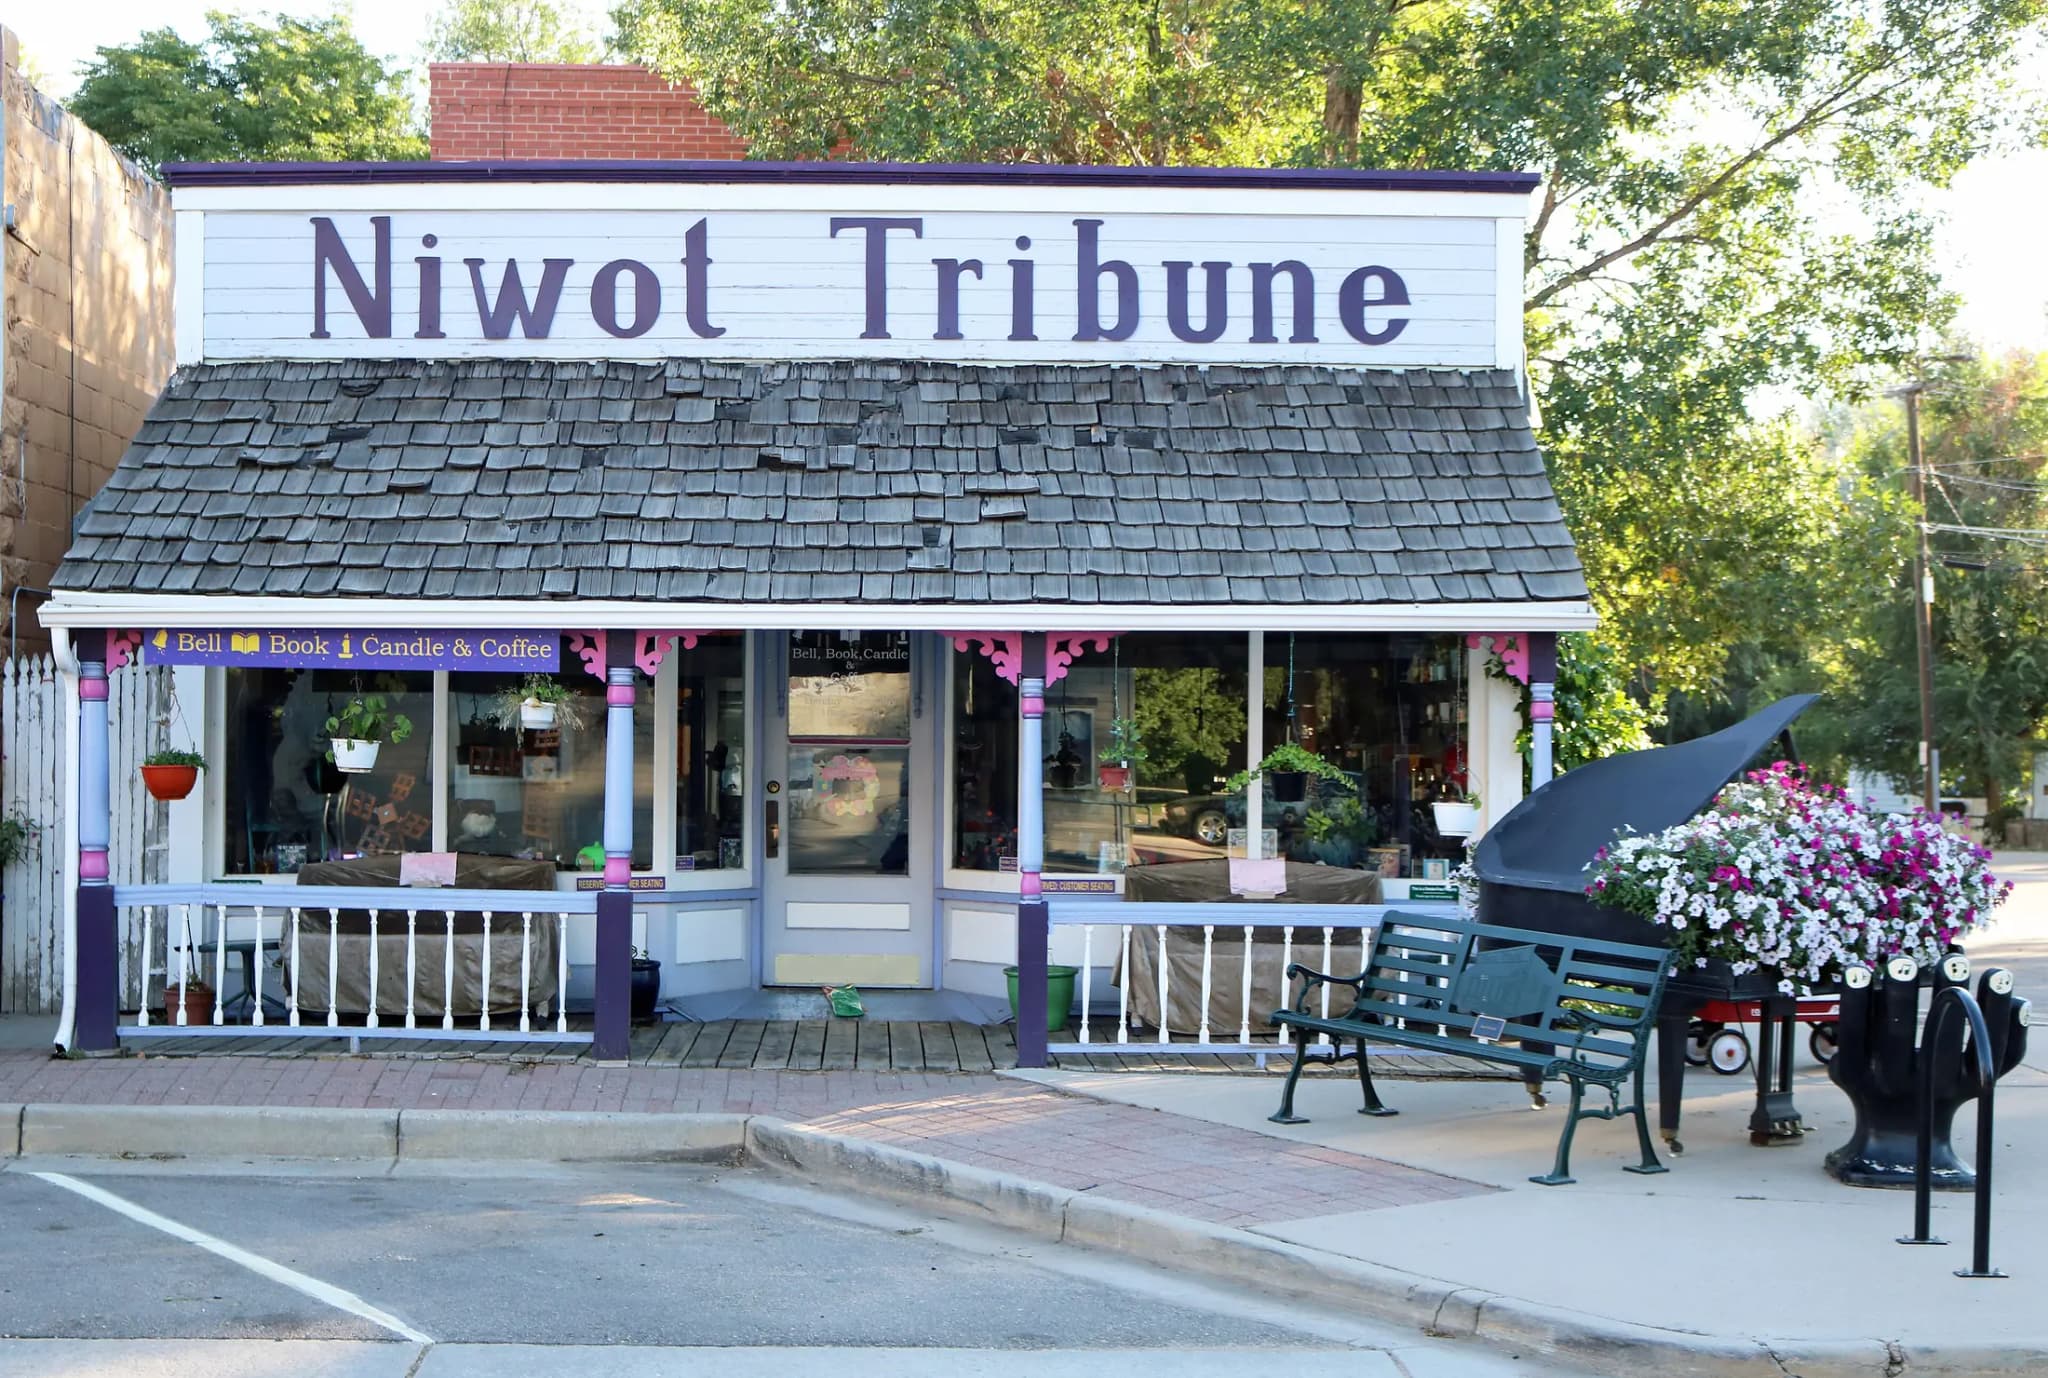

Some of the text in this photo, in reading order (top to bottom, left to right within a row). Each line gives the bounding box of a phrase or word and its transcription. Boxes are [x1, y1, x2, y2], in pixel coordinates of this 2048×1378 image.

[309, 216, 1412, 346] Niwot Tribune
[177, 632, 553, 658] Bell Book Candle & Coffee
[792, 648, 909, 661] Bell, Book, Candle
[845, 661, 856, 670] &
[640, 879, 664, 889] SEATING
